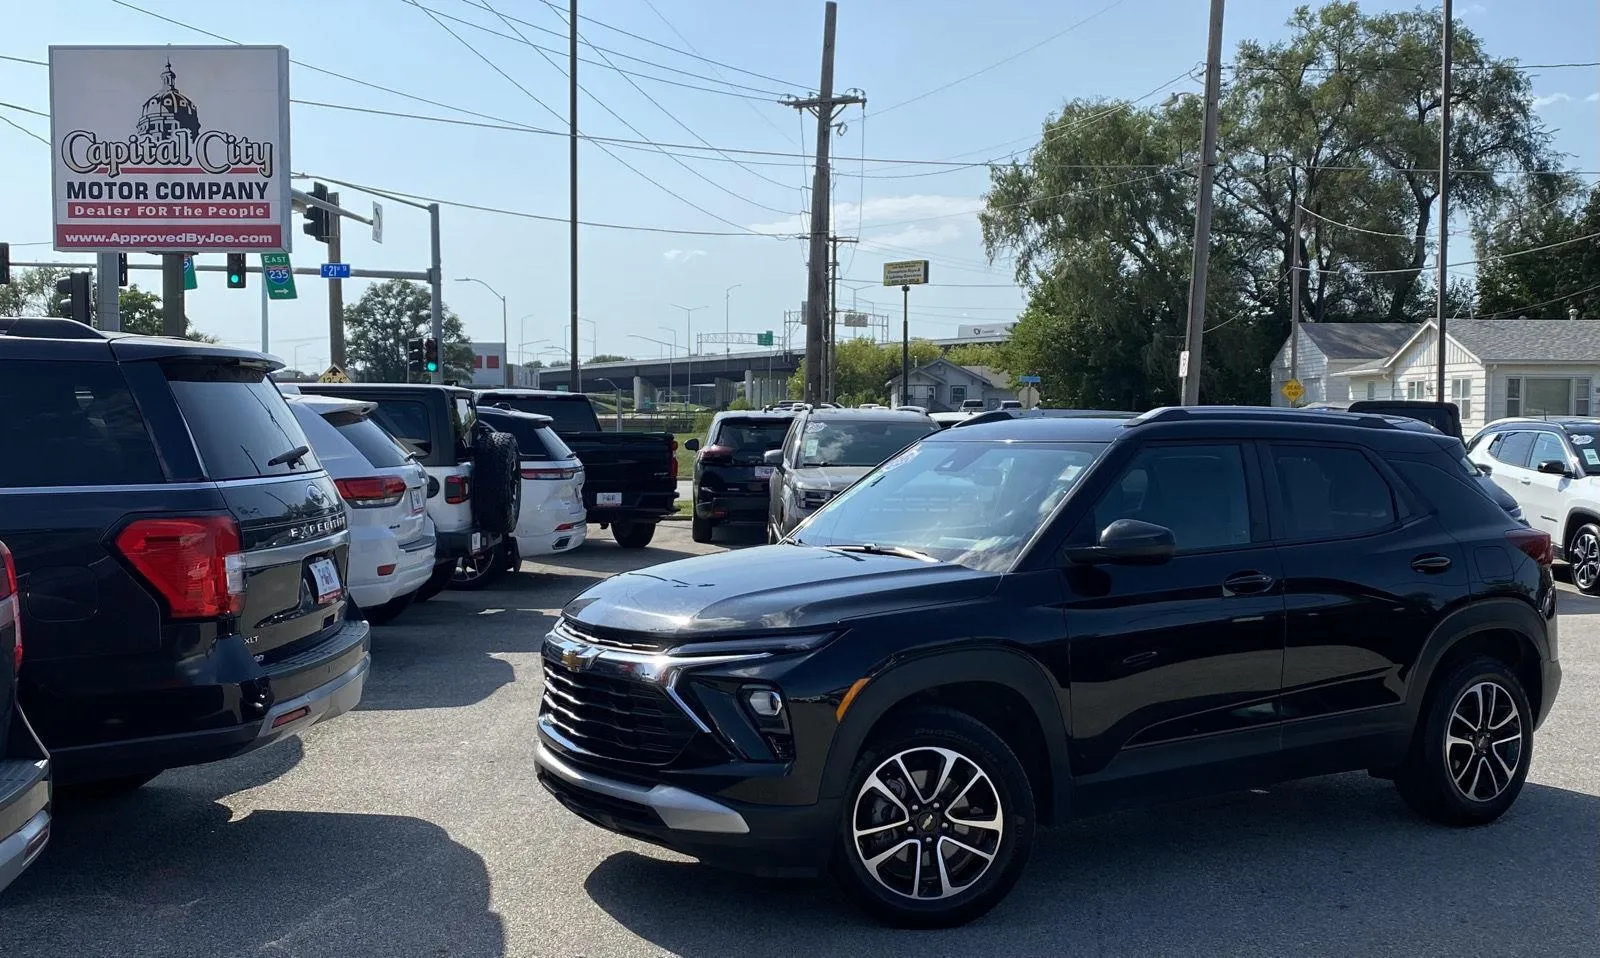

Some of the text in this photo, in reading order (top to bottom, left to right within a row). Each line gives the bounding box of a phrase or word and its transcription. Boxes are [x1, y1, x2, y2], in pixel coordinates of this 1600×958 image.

[61, 130, 273, 178] Capital City
[66, 181, 269, 200] MOTOR COMPANY
[74, 205, 265, 218] Dealer FOR The People
[65, 232, 273, 245] www.ApprovedByJoe.com
[264, 255, 287, 263] EAST
[269, 270, 289, 279] 235
[243, 635, 259, 645] XLT
